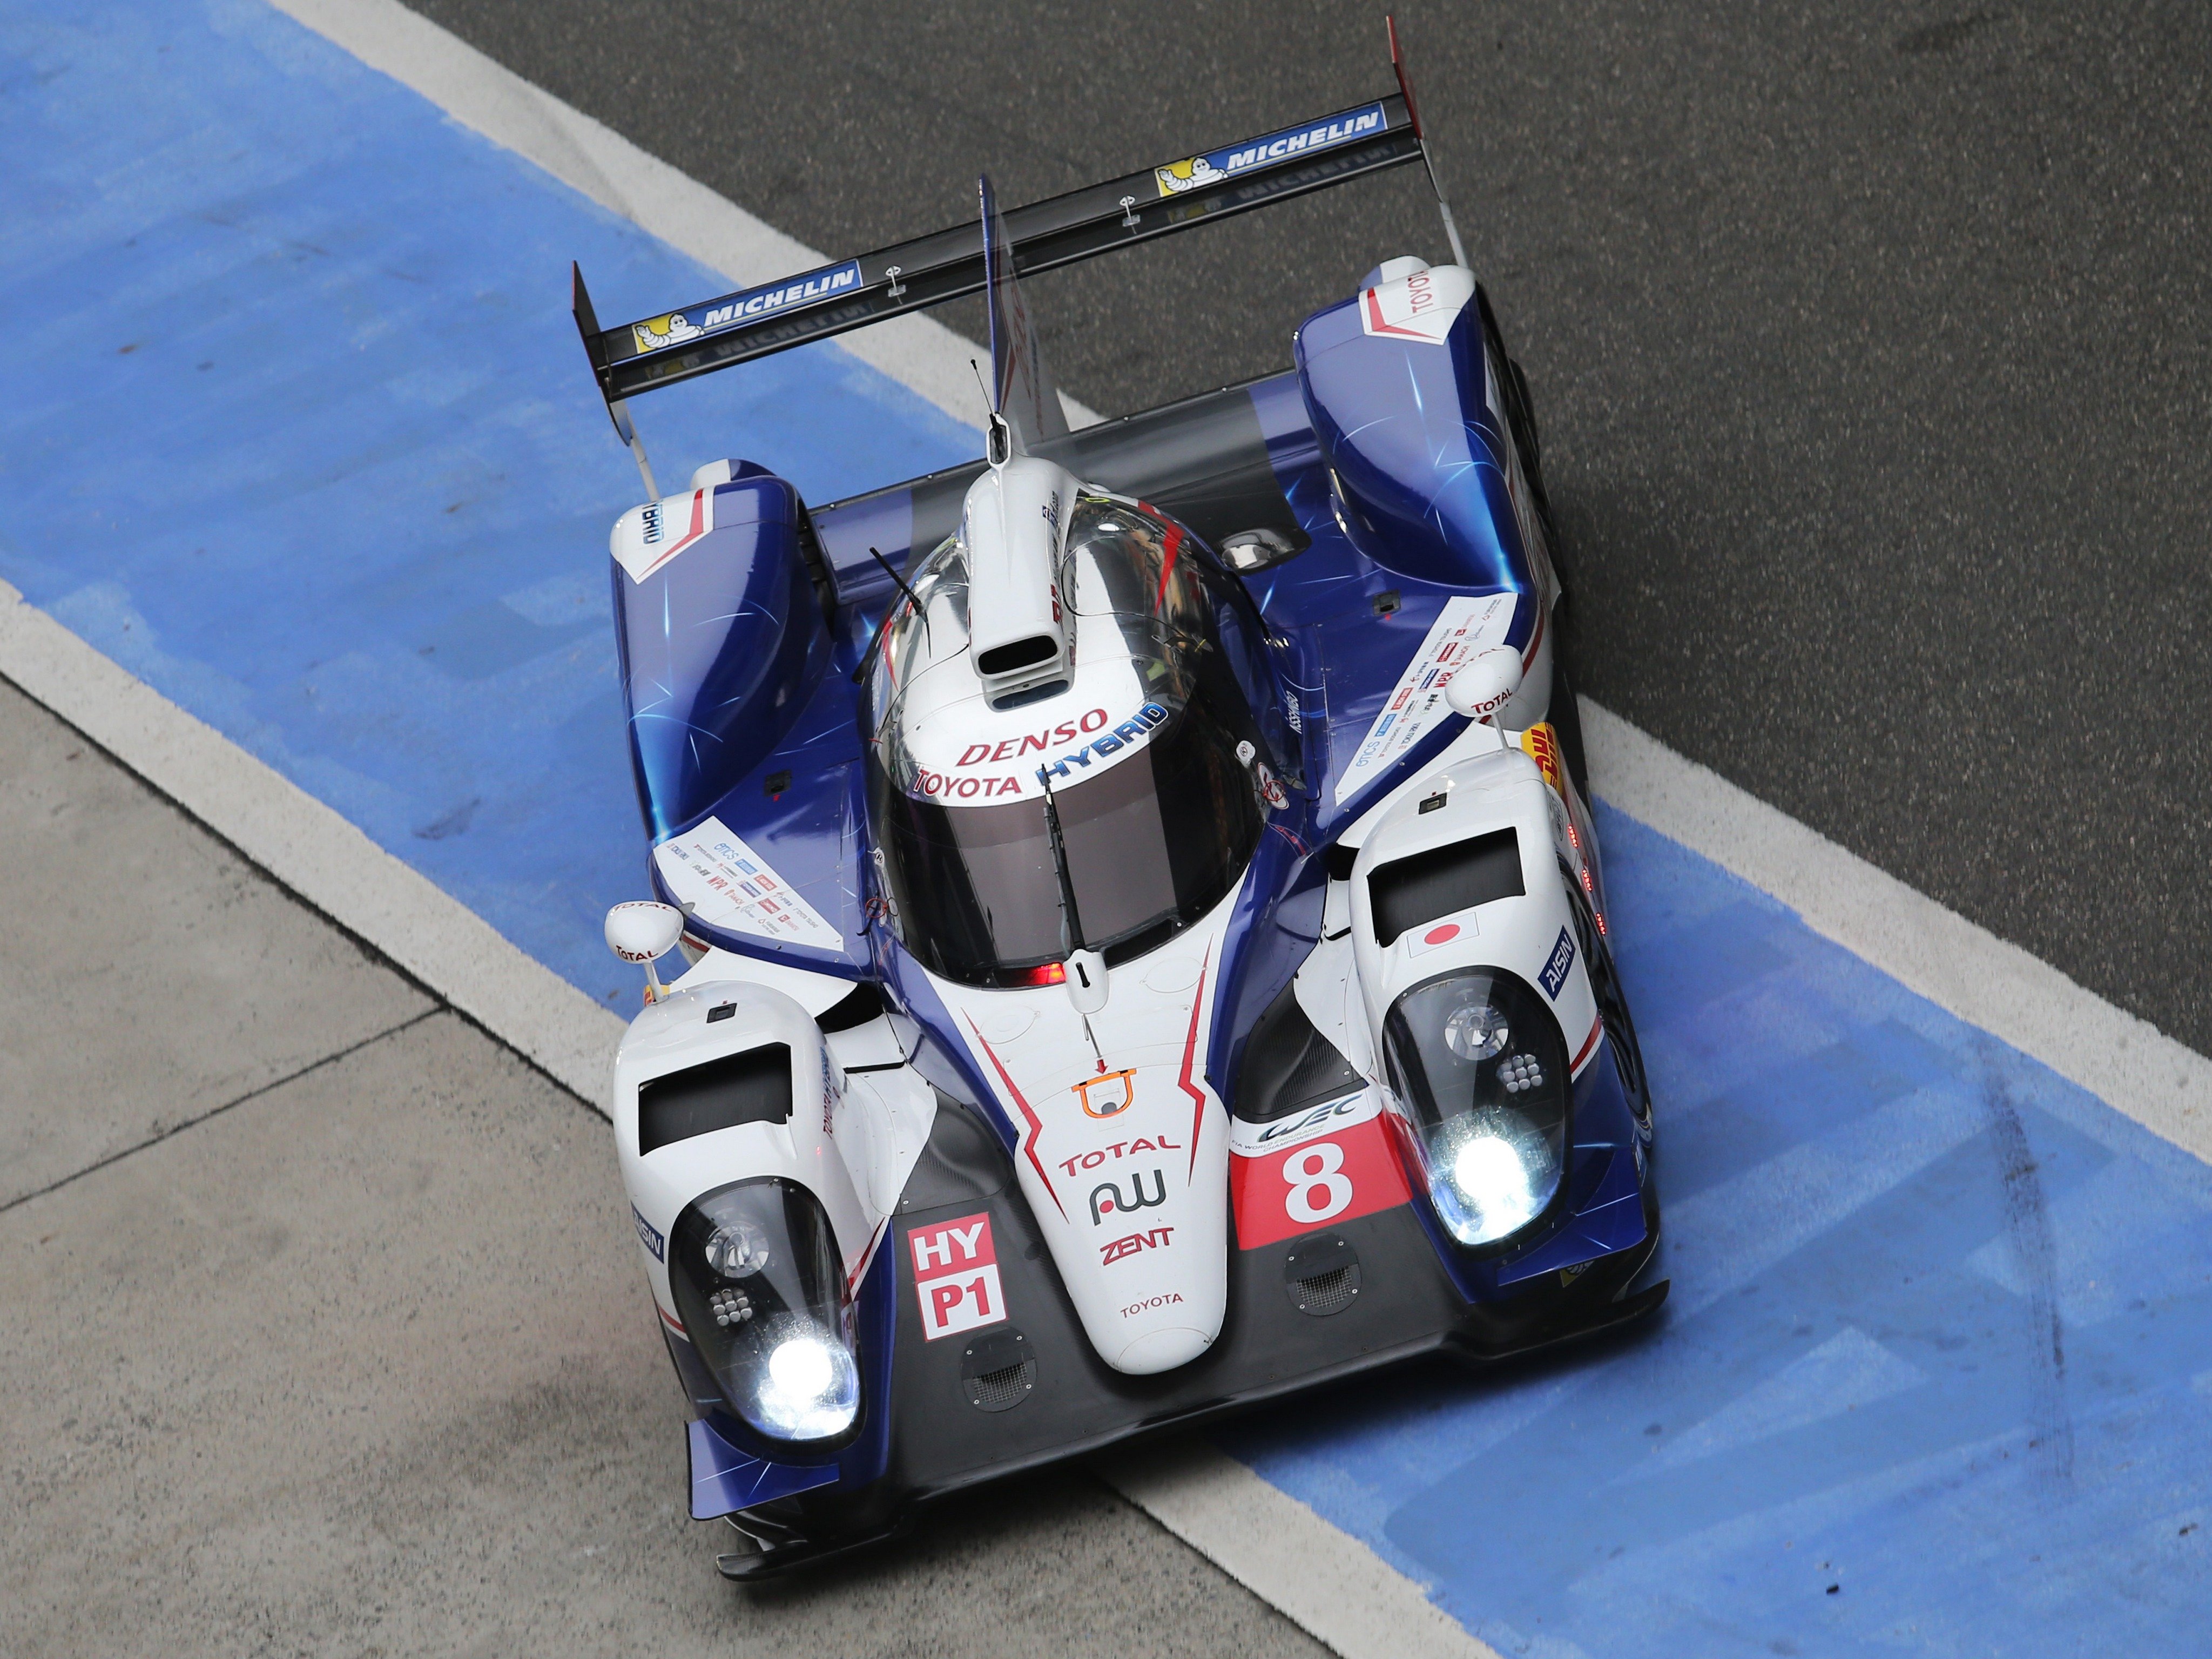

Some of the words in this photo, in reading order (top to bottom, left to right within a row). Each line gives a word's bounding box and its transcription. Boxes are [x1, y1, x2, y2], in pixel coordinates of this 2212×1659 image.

[1227, 111, 1378, 170] MICHELIN
[704, 268, 854, 326] MICHELIN
[1406, 271, 1433, 313] TOYOT
[1471, 688, 1513, 714] TOTAL
[914, 768, 1022, 797] TOYOTA
[1035, 702, 1169, 786] HYBRID
[956, 709, 1108, 766] DENSO
[706, 875, 728, 891] NPR
[616, 945, 658, 961] TOTAL
[1546, 934, 1572, 993] AISIN
[1231, 1139, 1243, 1148] FIA
[1245, 1141, 1273, 1150] WORLD
[1273, 1124, 1325, 1144] ENDURANCE
[1257, 1094, 1364, 1142] WEC
[1263, 1129, 1324, 1152] CHAMPIONSHIP
[1058, 1135, 1181, 1177] TOTAL
[1282, 1142, 1353, 1224] 8
[913, 1222, 984, 1271] HY
[1100, 1227, 1174, 1266] ZENT
[930, 1277, 990, 1328] P1
[1121, 1293, 1184, 1318] TOYOTA
